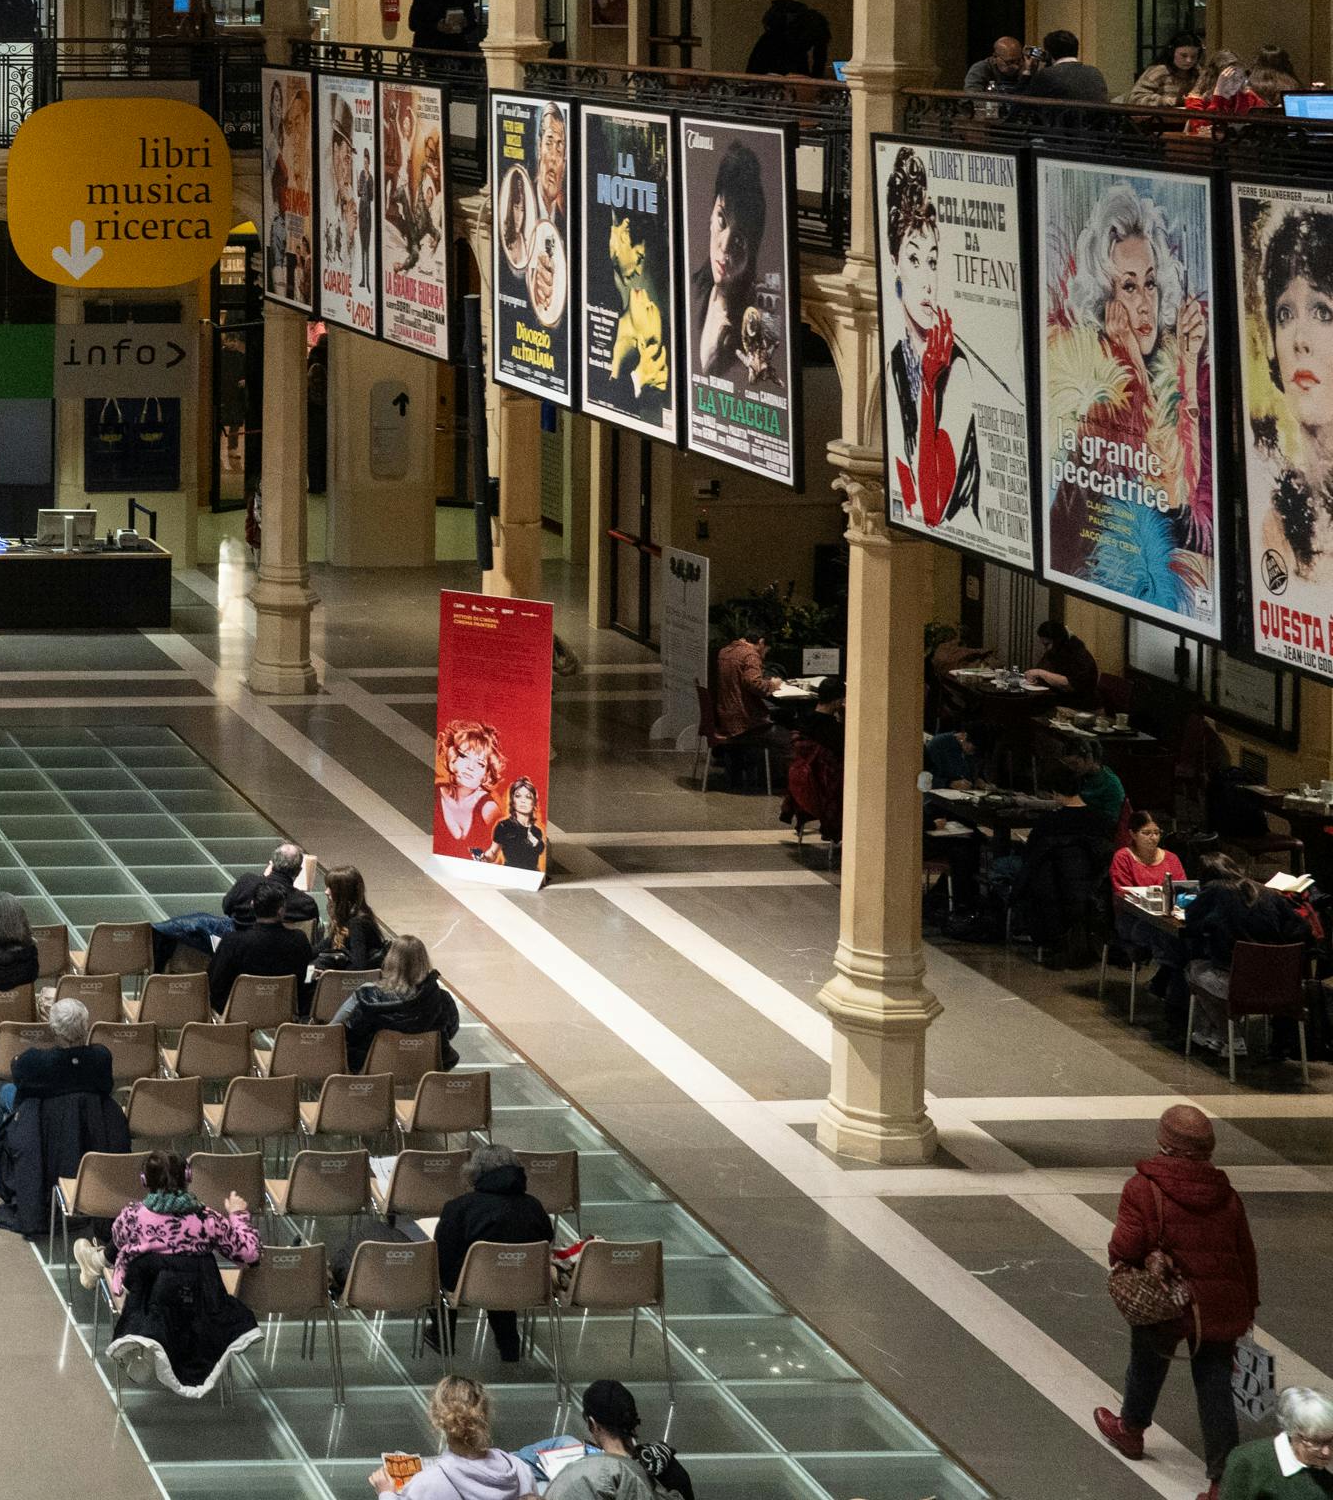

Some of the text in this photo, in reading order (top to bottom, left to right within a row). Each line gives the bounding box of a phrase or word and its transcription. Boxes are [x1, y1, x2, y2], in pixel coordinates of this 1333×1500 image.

[139, 137, 212, 168] libri
[617, 152, 636, 178] LA
[927, 150, 1015, 188] AUDREY HEPBURN
[86, 174, 213, 205] musica
[596, 173, 659, 215] NOTTE
[95, 210, 213, 241] ricerca
[937, 196, 1006, 232] COLAZIONE
[964, 231, 980, 252] DA
[952, 253, 1018, 292] TIFFANY
[697, 386, 781, 436] LA VIACCIA
[1058, 416, 1076, 452] la
[1082, 434, 1162, 477] grande
[1051, 457, 1170, 514] peccatrice
[1259, 599, 1325, 654] QUESTA
